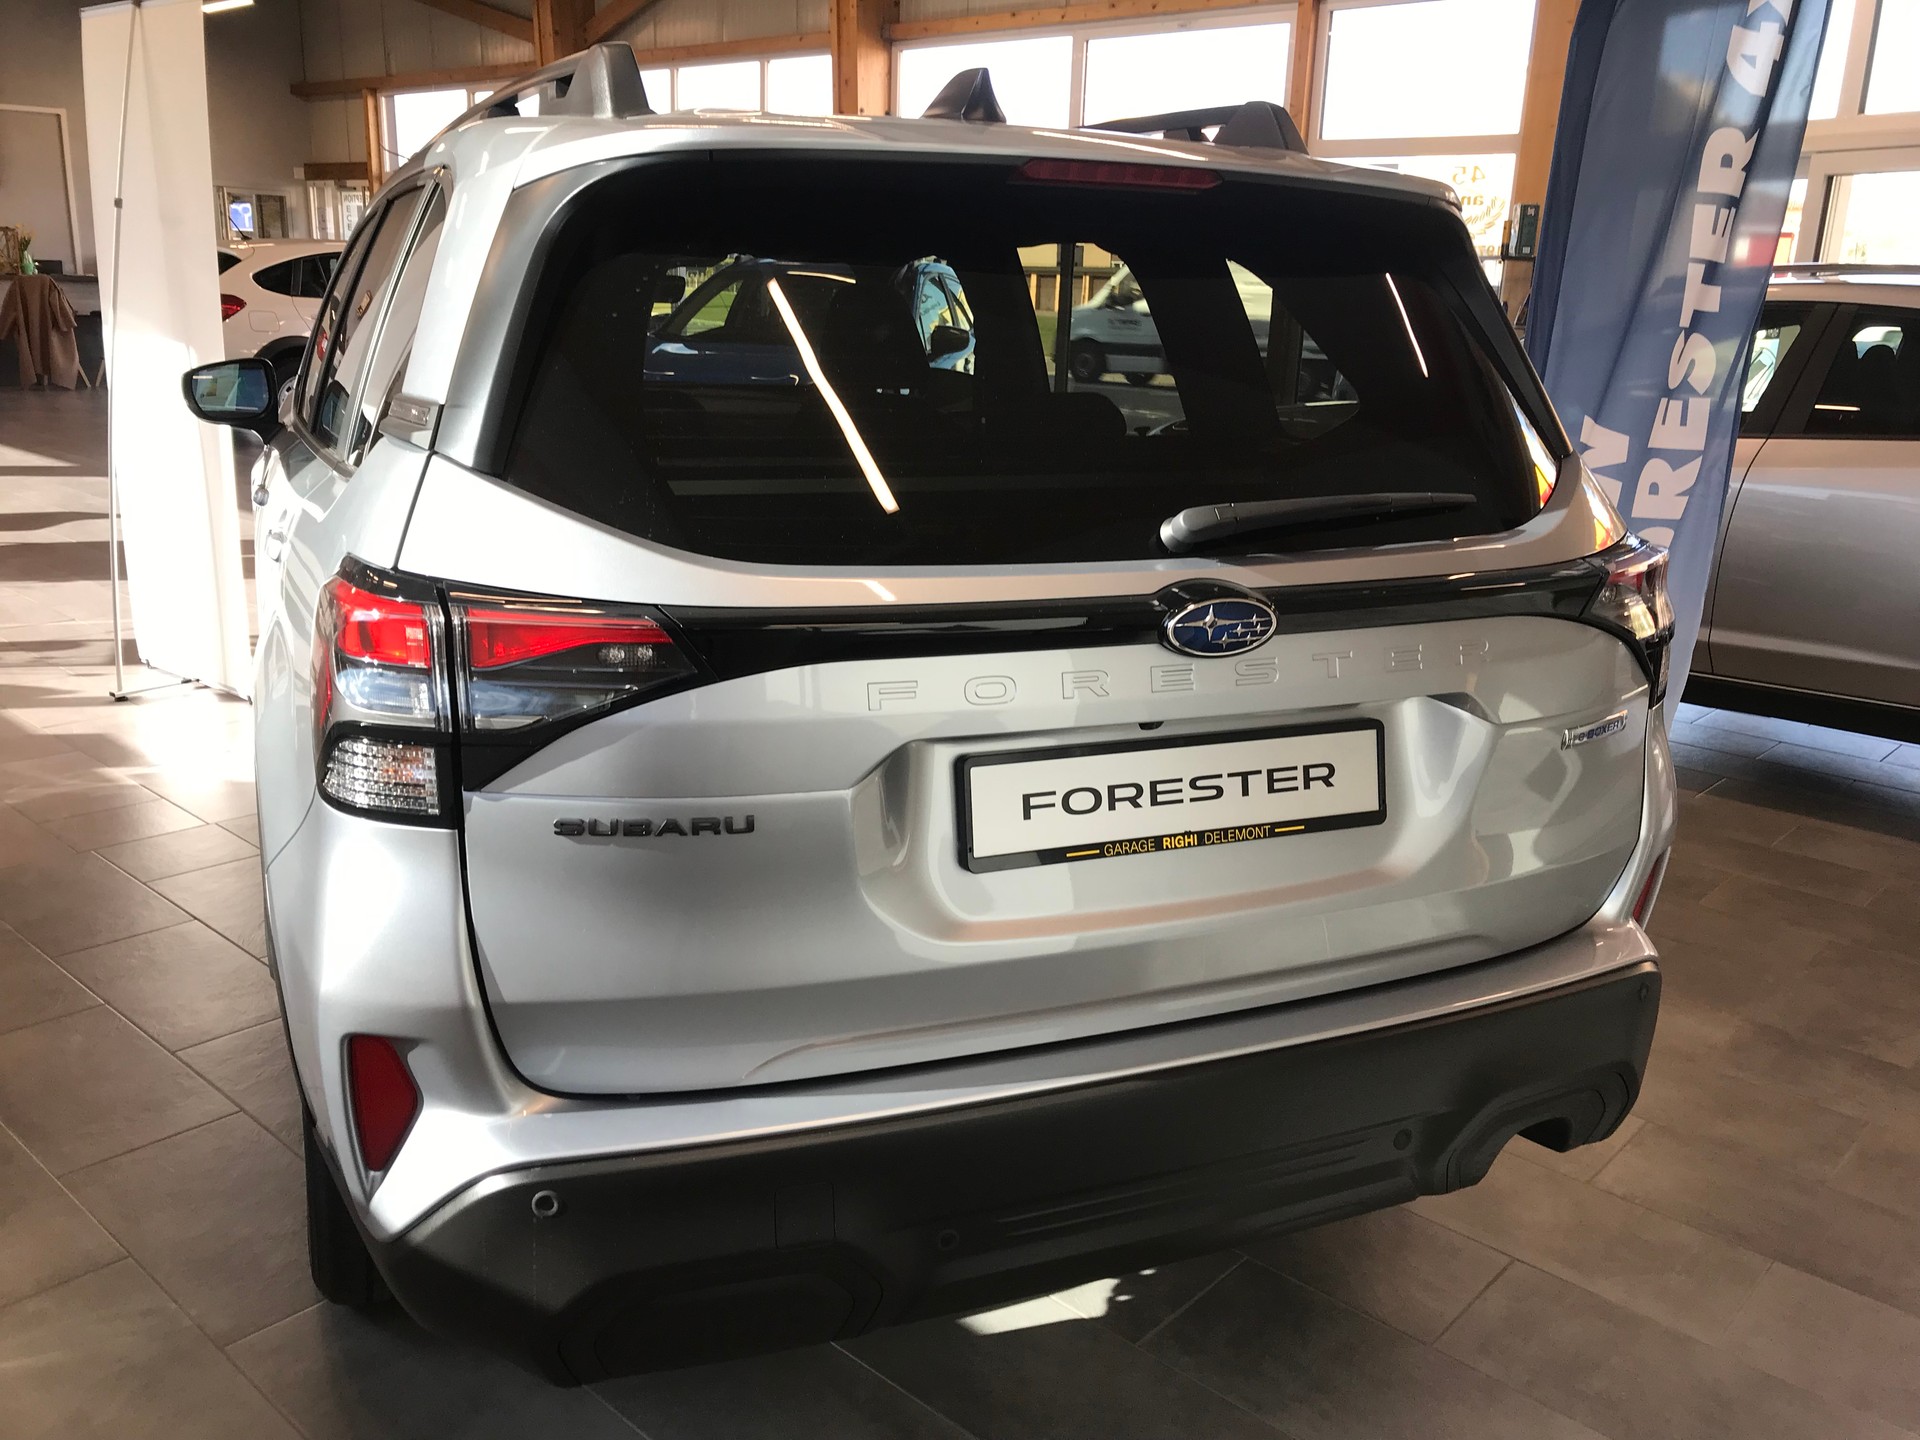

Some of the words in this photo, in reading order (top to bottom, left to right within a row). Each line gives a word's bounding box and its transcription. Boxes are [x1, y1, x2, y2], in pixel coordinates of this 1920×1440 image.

[867, 639, 1492, 711] FORESTER
[1022, 762, 1336, 820] FORESTER
[553, 815, 755, 837] SUBARU
[1103, 839, 1156, 857] GARAGE
[1162, 834, 1198, 850] RIGHI
[1204, 825, 1271, 845] DELEMONT
